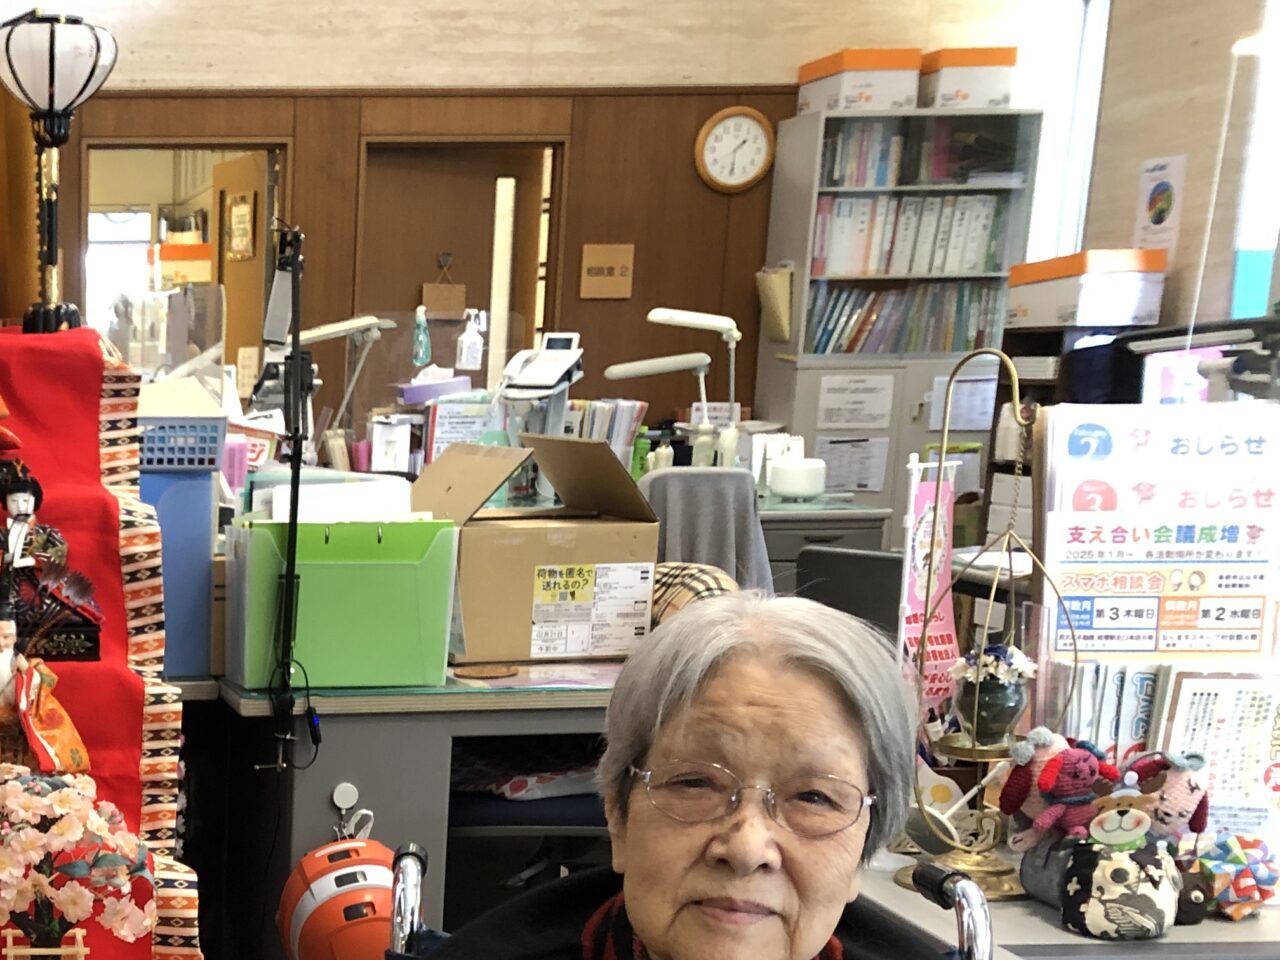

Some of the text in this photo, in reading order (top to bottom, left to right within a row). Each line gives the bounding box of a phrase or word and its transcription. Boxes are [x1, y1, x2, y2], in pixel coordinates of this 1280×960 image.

[1170, 434, 1268, 456] おしらせ
[1177, 487, 1276, 509] おしらせ
[1066, 523, 1241, 545] 支え合い会議成増
[536, 567, 594, 580] 荷物を匿名で
[1061, 571, 1165, 593] スマホ相談会
